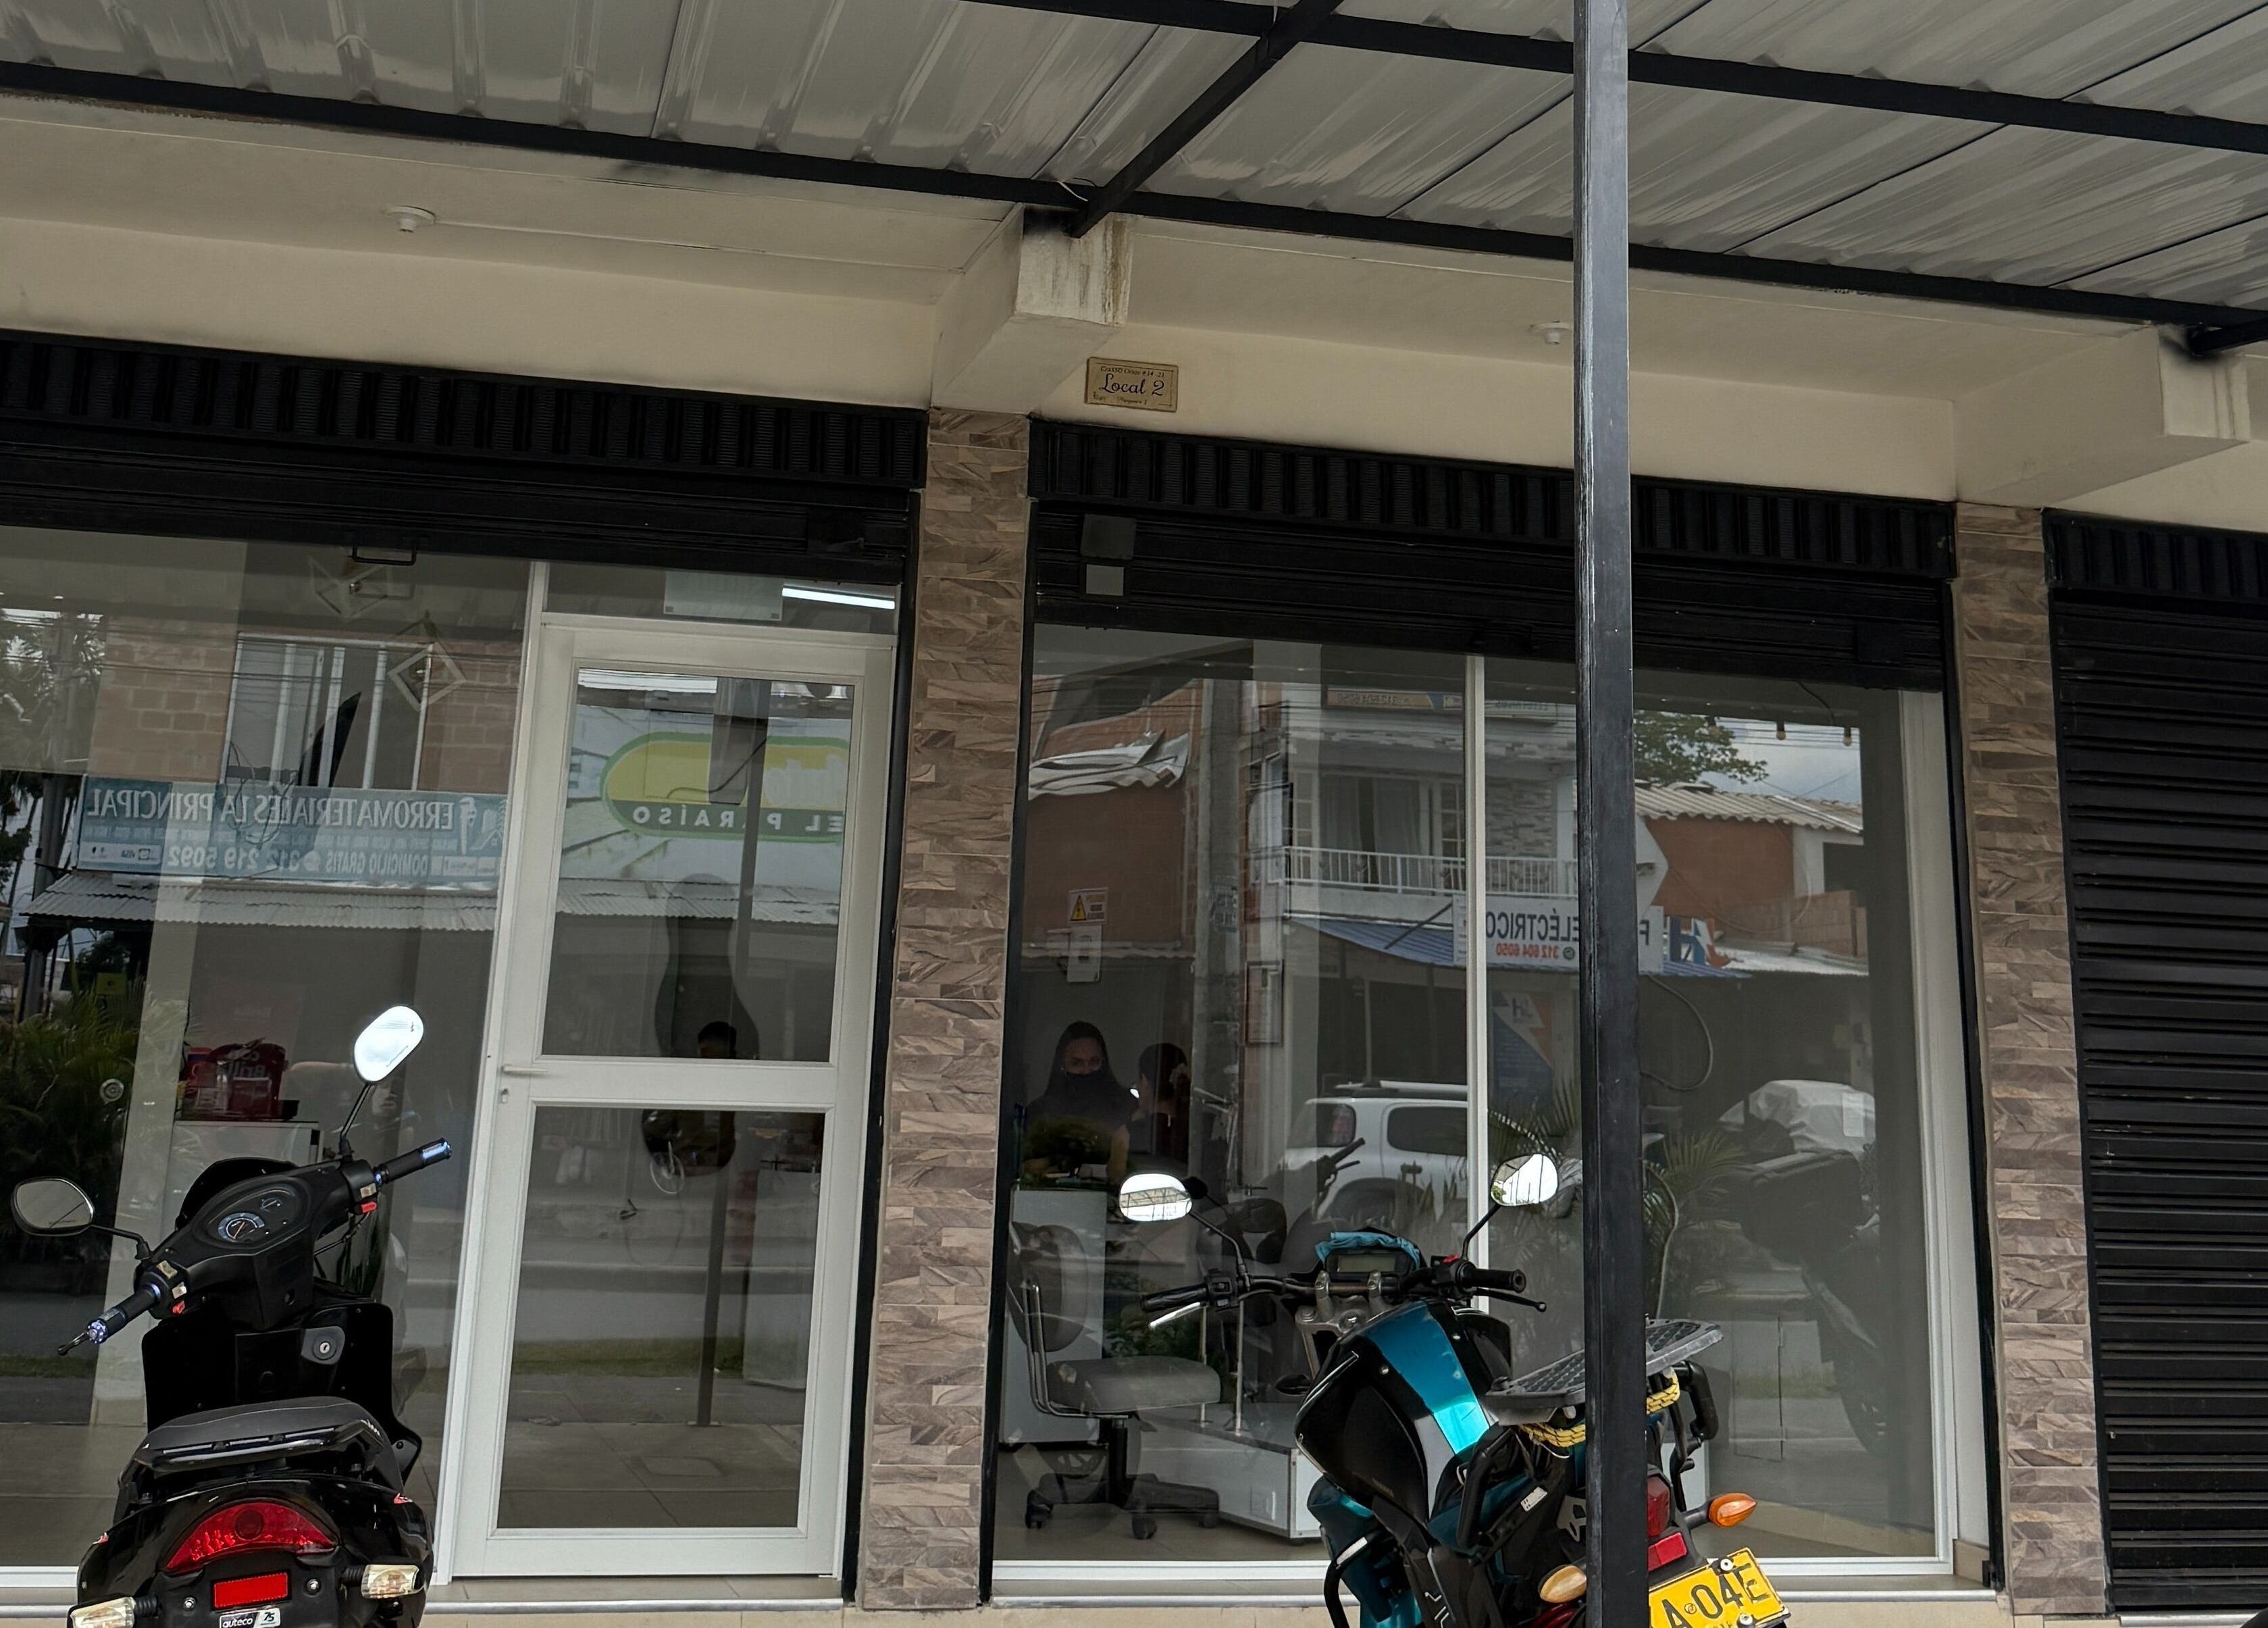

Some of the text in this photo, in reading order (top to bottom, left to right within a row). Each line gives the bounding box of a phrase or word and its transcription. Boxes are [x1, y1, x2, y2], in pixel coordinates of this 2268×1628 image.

[1098, 373, 1164, 397] Local 2
[263, 1612, 275, 1621] 75
[222, 1617, 253, 1628] auteco
